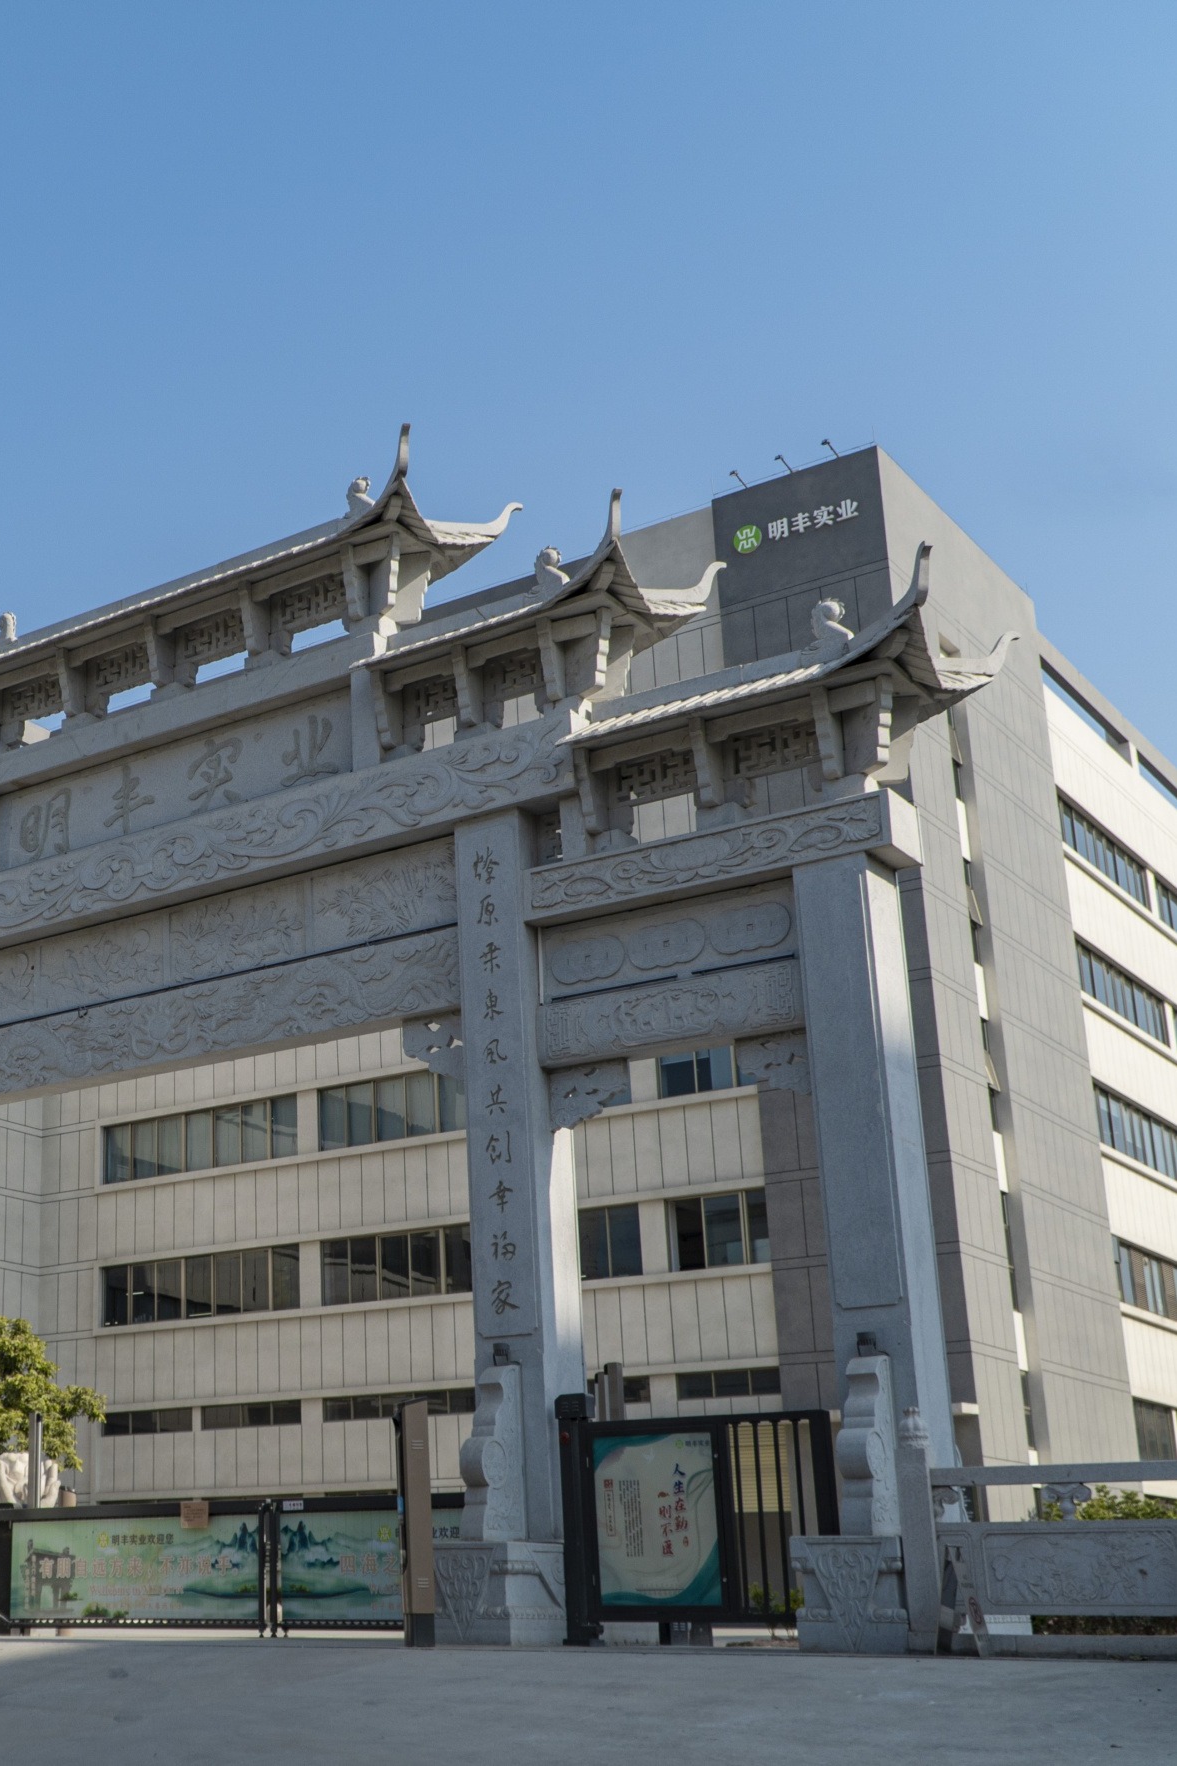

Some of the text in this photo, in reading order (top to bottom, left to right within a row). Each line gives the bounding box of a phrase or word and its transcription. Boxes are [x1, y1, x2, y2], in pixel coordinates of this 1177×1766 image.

[767, 499, 859, 540] 明丰实业
[19, 714, 339, 861] 明丰实业
[111, 1533, 174, 1546] 明丰实业欢迎您
